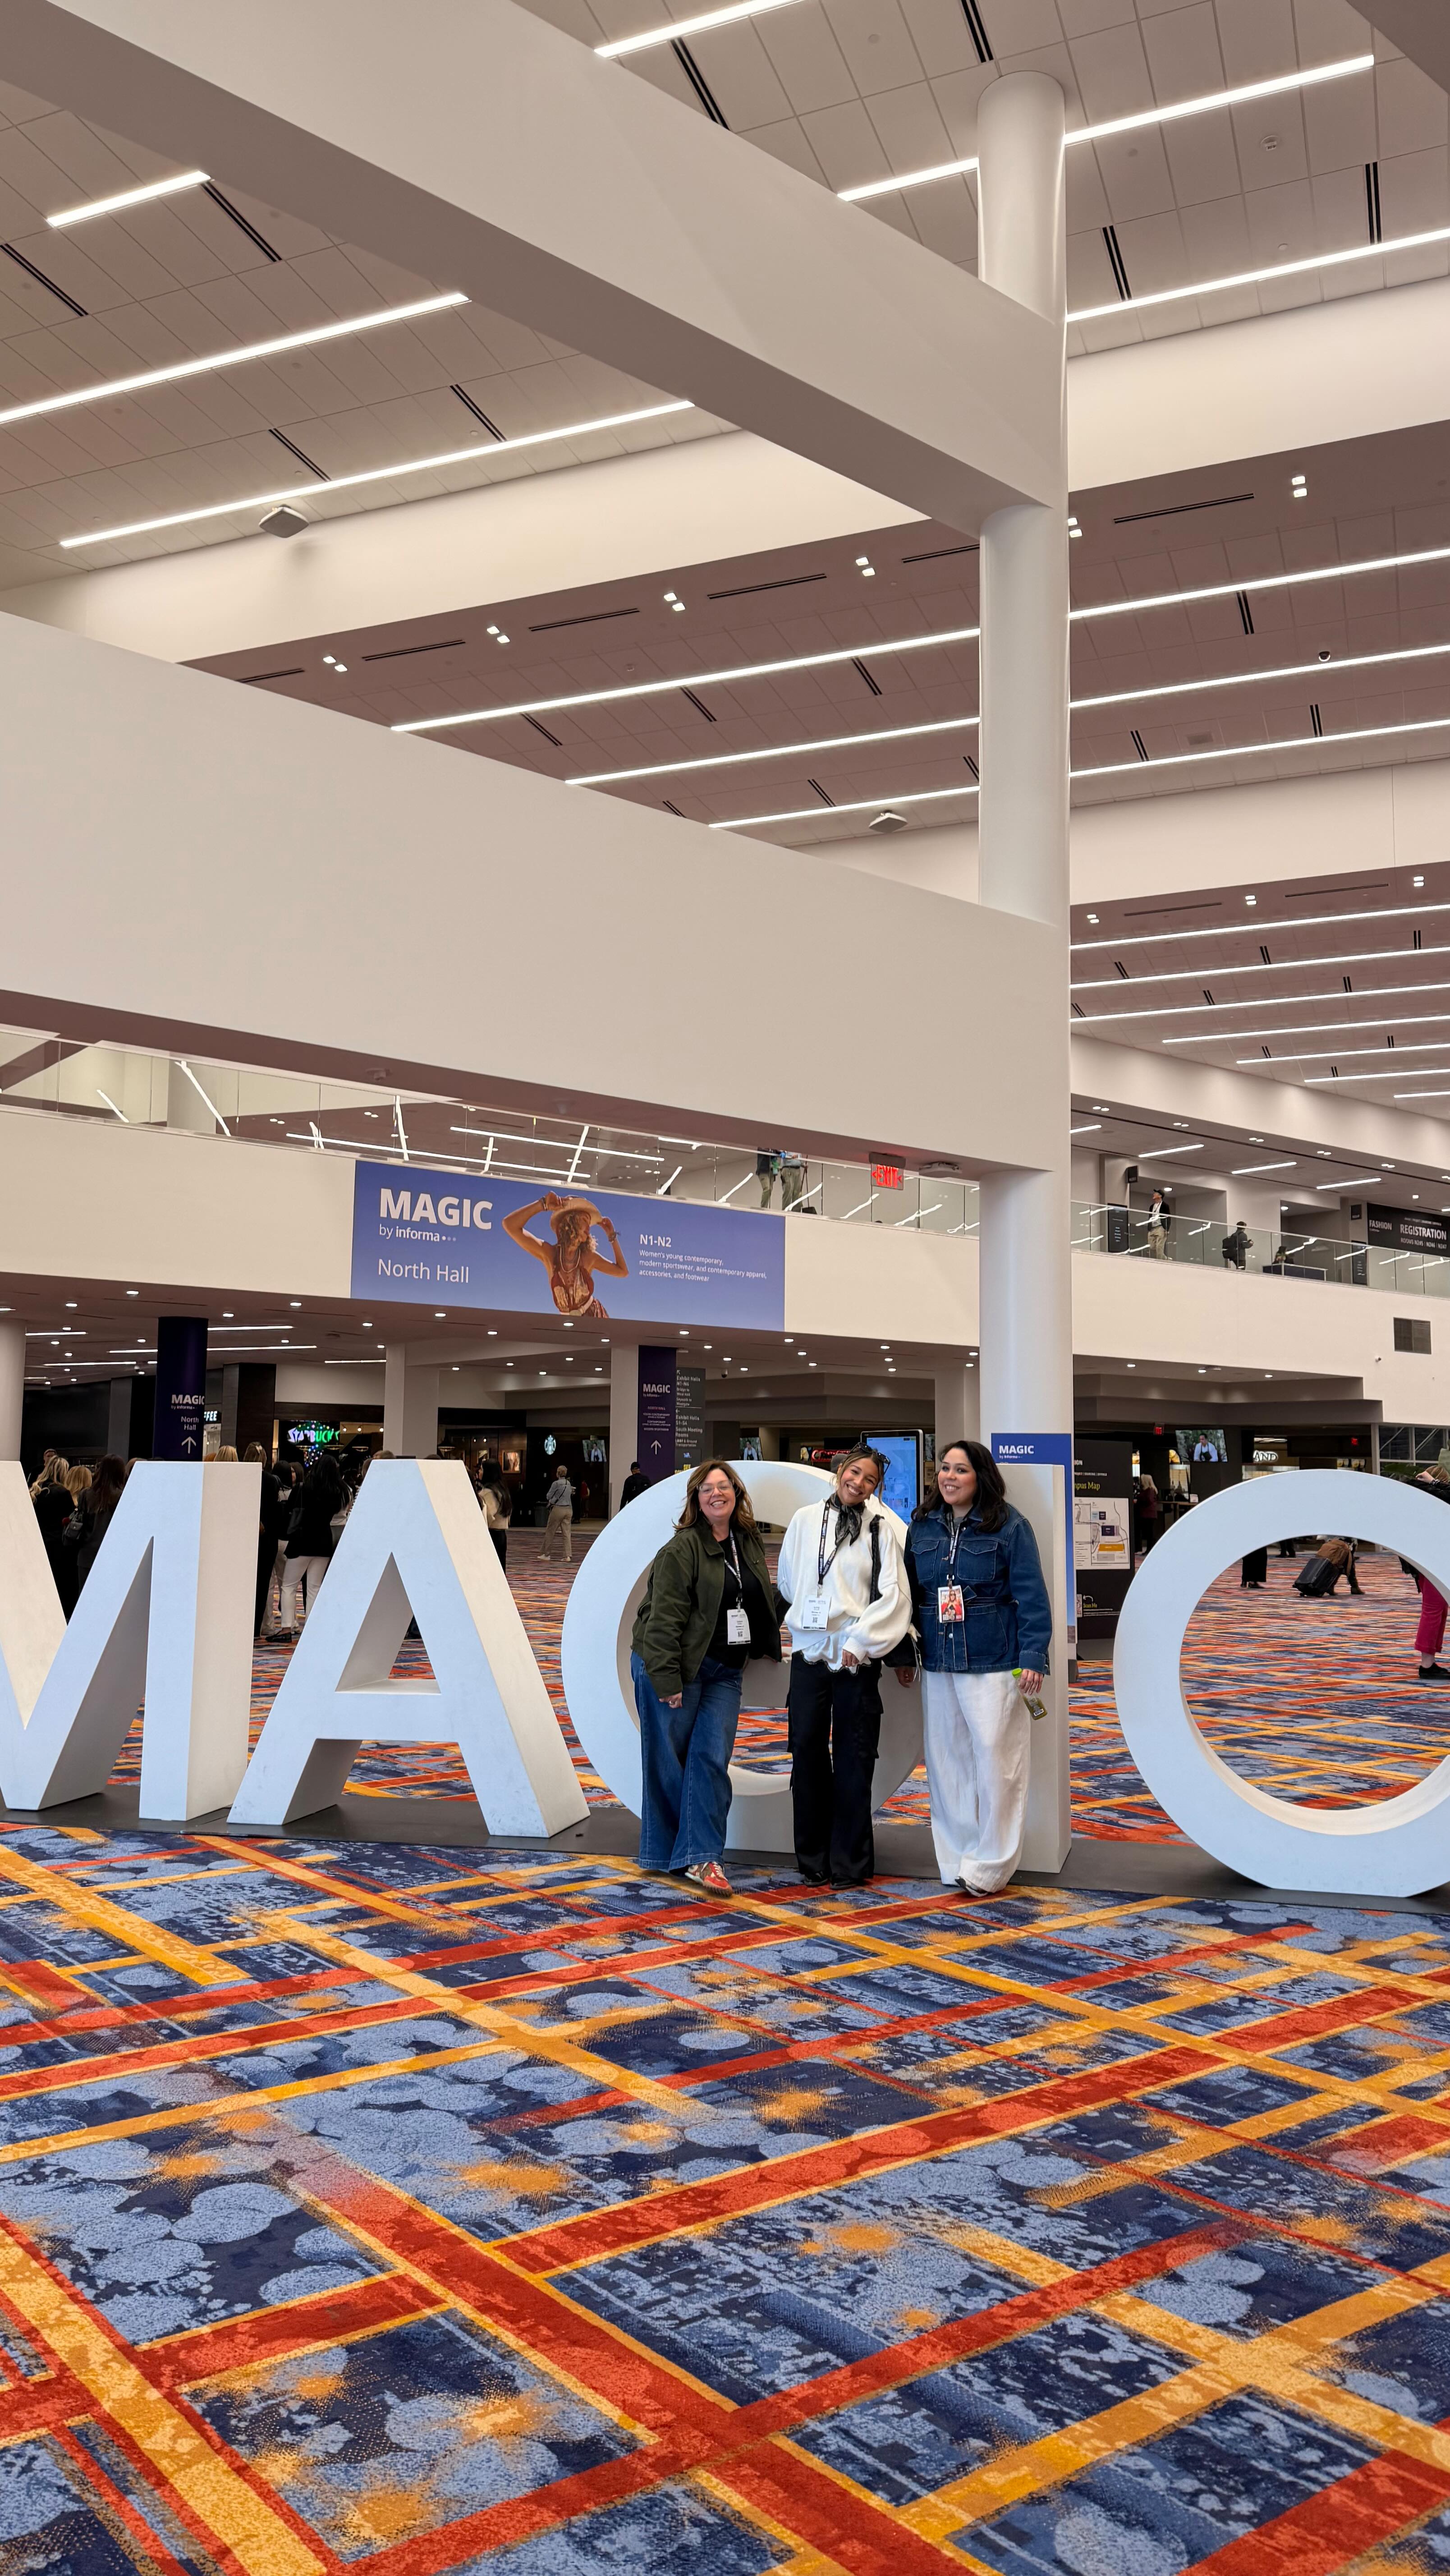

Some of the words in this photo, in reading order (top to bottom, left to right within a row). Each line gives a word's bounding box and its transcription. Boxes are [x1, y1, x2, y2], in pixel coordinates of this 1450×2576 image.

[876, 1164, 898, 1189] EXIT
[380, 1188, 493, 1230] MAGIC
[379, 1224, 393, 1239] by
[396, 1226, 440, 1242] informa
[1400, 1224, 1447, 1240] REGISTRATION
[640, 1234, 671, 1247] N1-N2
[639, 1250, 665, 1258] Women's
[666, 1253, 683, 1262] young
[684, 1255, 724, 1266] contemporary,
[378, 1259, 430, 1280] North
[437, 1265, 469, 1283] Hall
[639, 1270, 672, 1279] accessories,
[685, 1273, 709, 1282] footwear
[707, 1267, 744, 1278] contemporary
[643, 1383, 670, 1393] MAGIC
[172, 1394, 205, 1405] MAGIC
[999, 1445, 1034, 1454] MAGIC
[1088, 1481, 1100, 1491] Map
